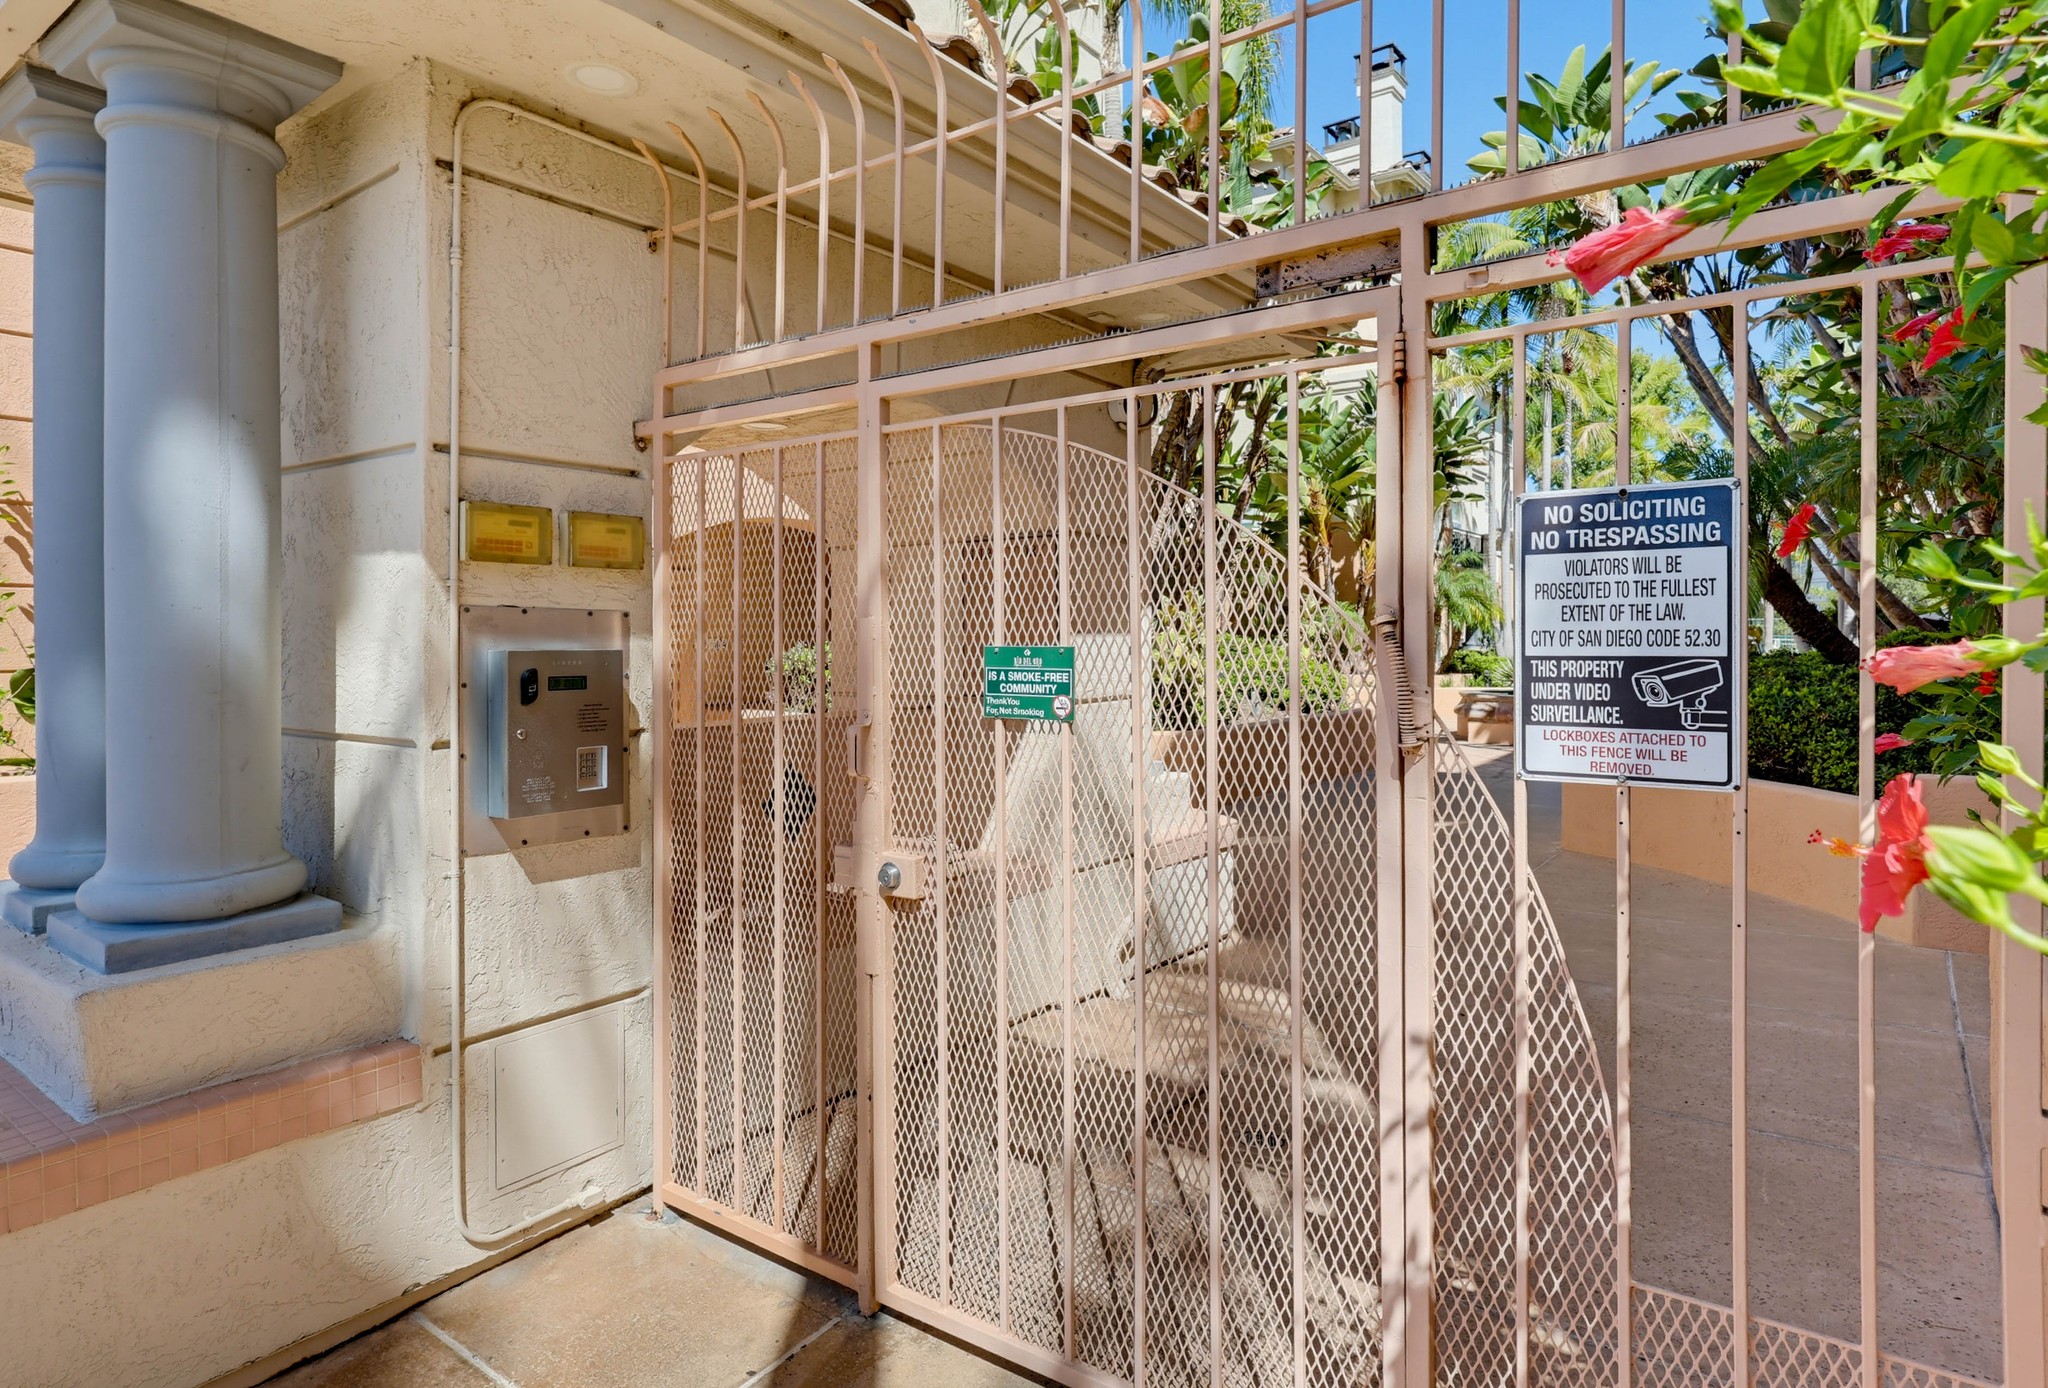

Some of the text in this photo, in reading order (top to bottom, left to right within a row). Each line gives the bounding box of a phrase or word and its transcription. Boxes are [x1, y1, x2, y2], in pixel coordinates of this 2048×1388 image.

[1544, 495, 1706, 525] NO SOLICITING
[1531, 521, 1721, 550] NO TRESPASSING
[1564, 555, 1682, 577] VIOLATORS WILL BE
[1535, 578, 1716, 600] PROSECUTED TO THE FULLEST
[1561, 603, 1686, 622] EXTENT OF THE LAW.
[1531, 628, 1721, 647] CITY OF SAN DIEGO CODE 52.30
[988, 670, 1069, 682] IS A SMOKE-FREE
[1530, 660, 1625, 679] THIS PROPERTY
[1000, 683, 1057, 694] COMMUNITY
[1530, 682, 1611, 701] UNDER VIDEO
[999, 706, 1012, 715] Not
[1013, 707, 1044, 717] Smoking
[1530, 704, 1624, 725] SURVEILLANCE.
[1543, 729, 1707, 747] LOCKBOXES ATTACHED TO
[1559, 744, 1688, 762] THIS FENCE WILL BE
[1590, 761, 1655, 777] REMOVED.
